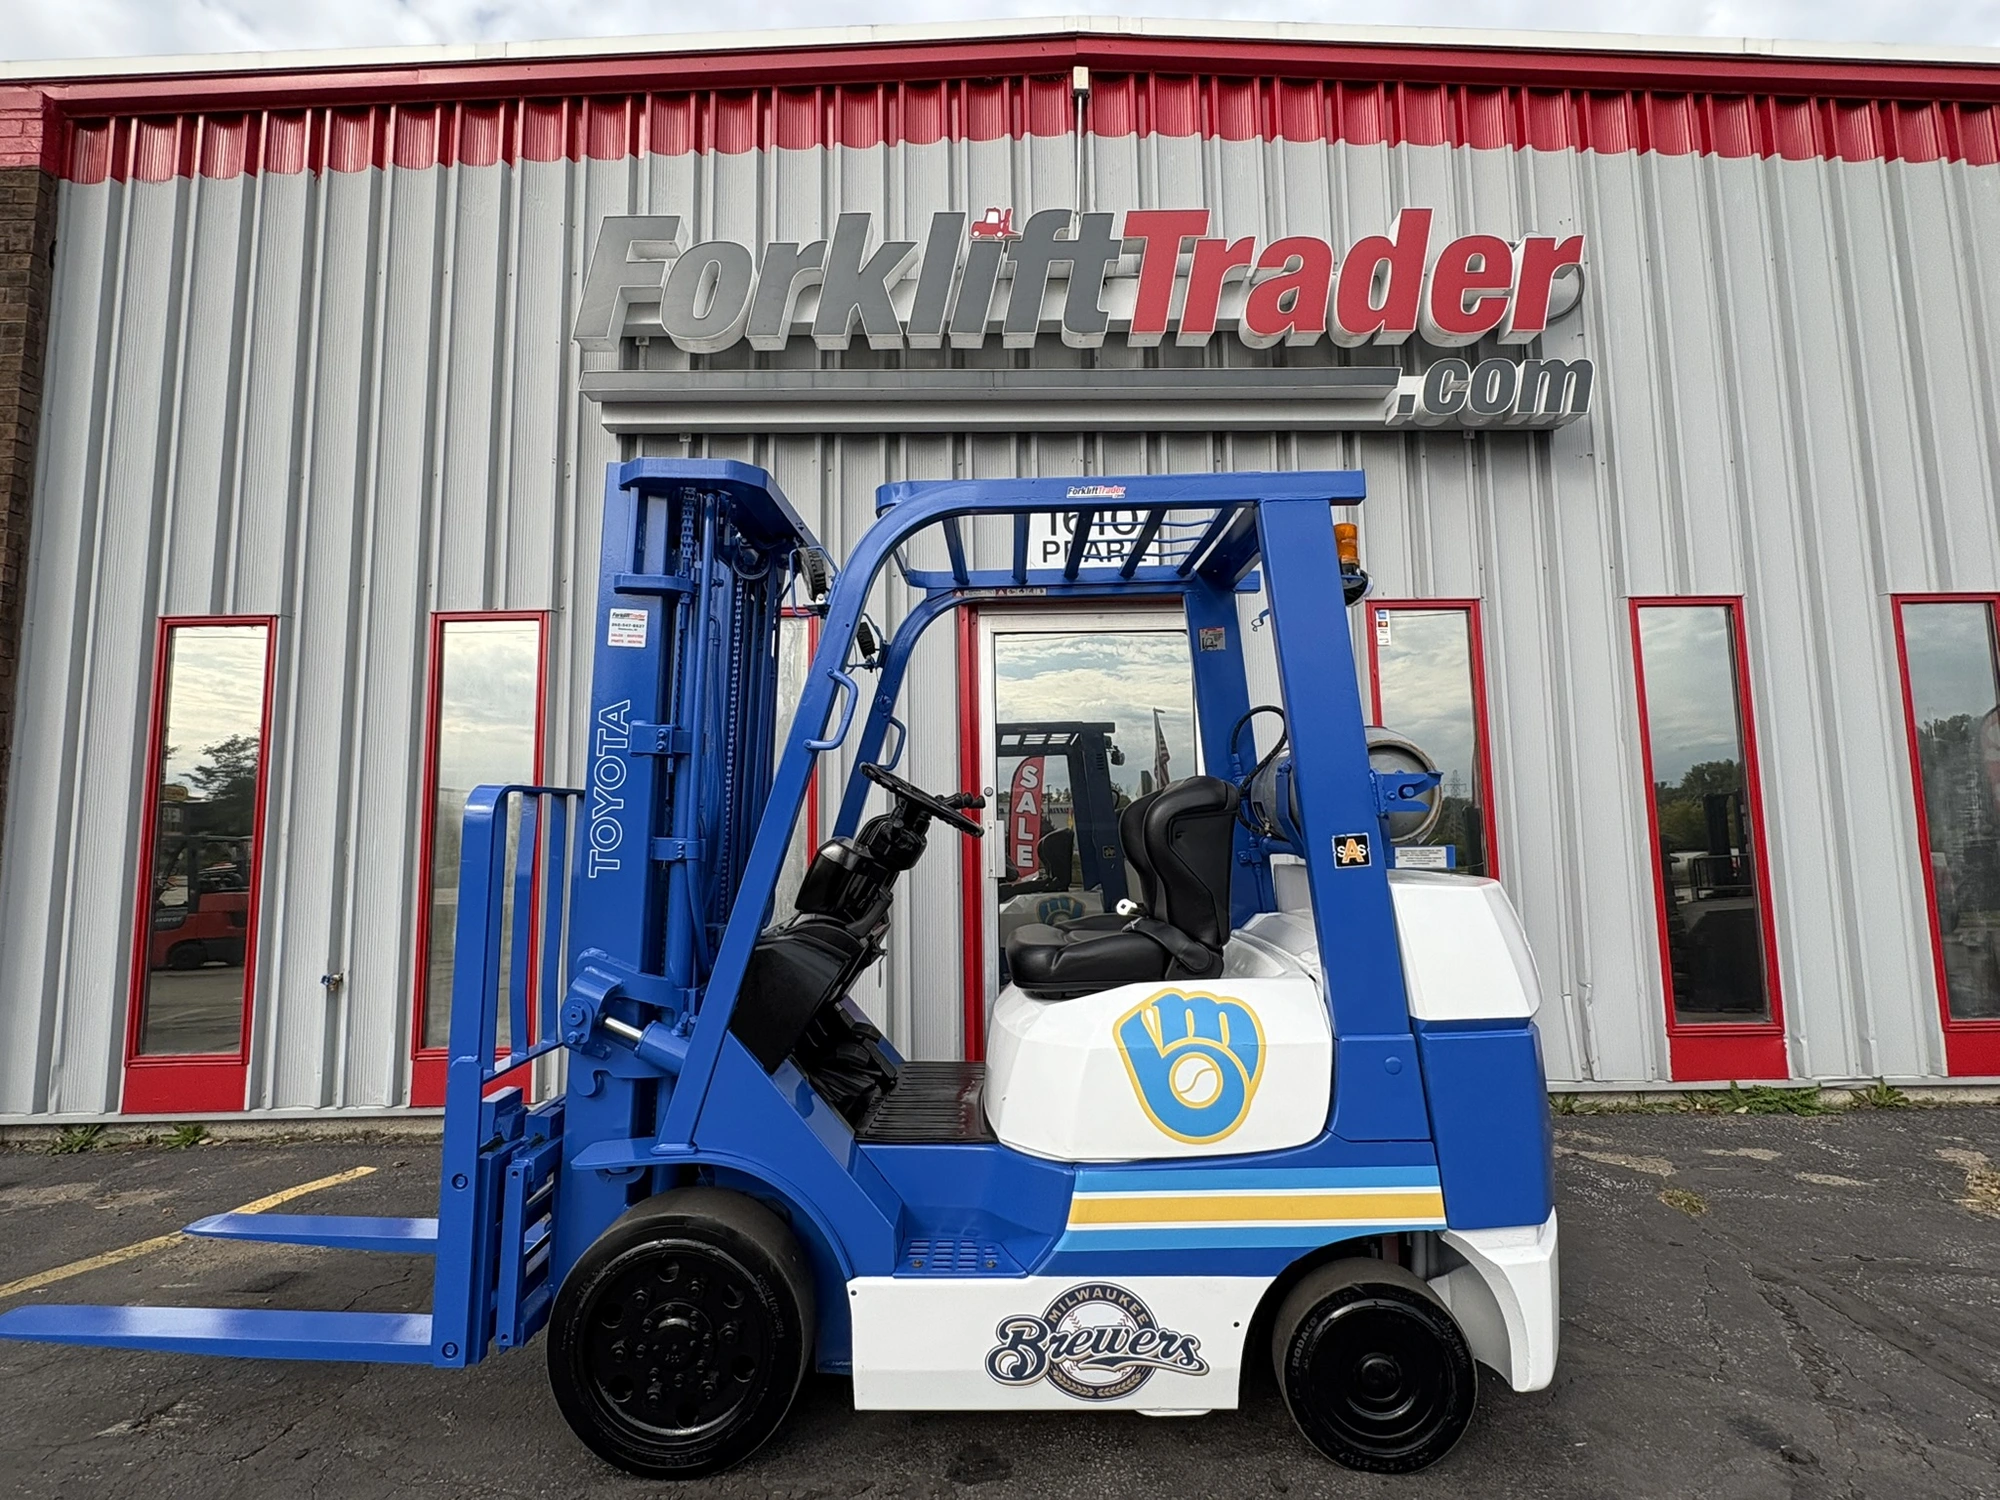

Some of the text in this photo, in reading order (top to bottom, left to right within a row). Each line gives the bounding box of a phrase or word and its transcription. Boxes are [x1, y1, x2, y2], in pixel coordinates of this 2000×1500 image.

[573, 207, 1584, 342] ForkliftTrader
[1396, 357, 1595, 417] .com
[1042, 540, 1148, 563] PAR
[588, 699, 631, 879] TOYOTA
[1015, 765, 1040, 869] SALE
[1336, 838, 1367, 864] SAS
[1048, 1287, 1150, 1326] MILWAUKEE
[984, 1313, 1211, 1388] Brewers
